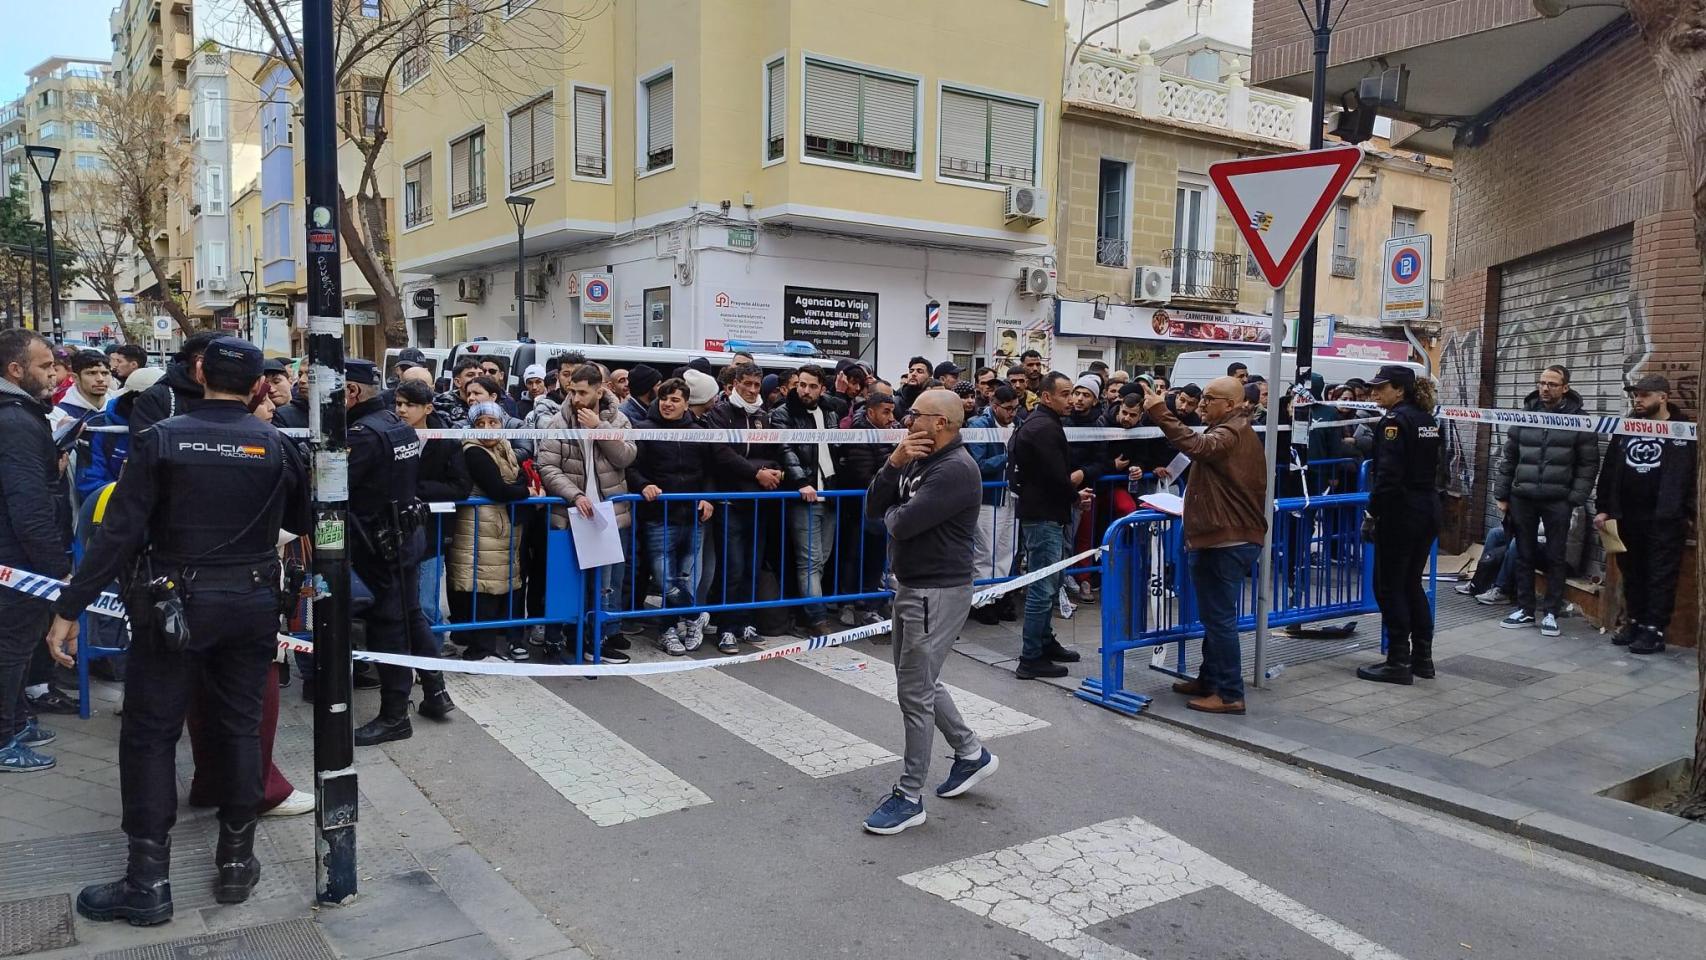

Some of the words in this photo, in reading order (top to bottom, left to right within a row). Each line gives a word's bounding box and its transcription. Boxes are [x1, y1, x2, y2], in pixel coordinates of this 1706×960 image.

[795, 295, 833, 308] Agencia
[834, 298, 846, 308] De
[847, 299, 869, 312] Viaje
[804, 309, 825, 318] VENTA
[834, 311, 860, 320] BILLETES
[1185, 312, 1214, 321] CARNICERIA
[1214, 314, 1230, 323] HALAL
[790, 315, 820, 326] Destino
[820, 318, 849, 329] Argelia
[849, 320, 855, 330] y
[1495, 411, 1526, 423] POLICIA
[1527, 413, 1539, 424] DE
[1540, 414, 1581, 428] NACIONAL
[1624, 420, 1653, 433] PASAR
[1656, 423, 1669, 435] NO
[179, 442, 246, 453] POLICIA
[221, 452, 265, 460] NACIONAL
